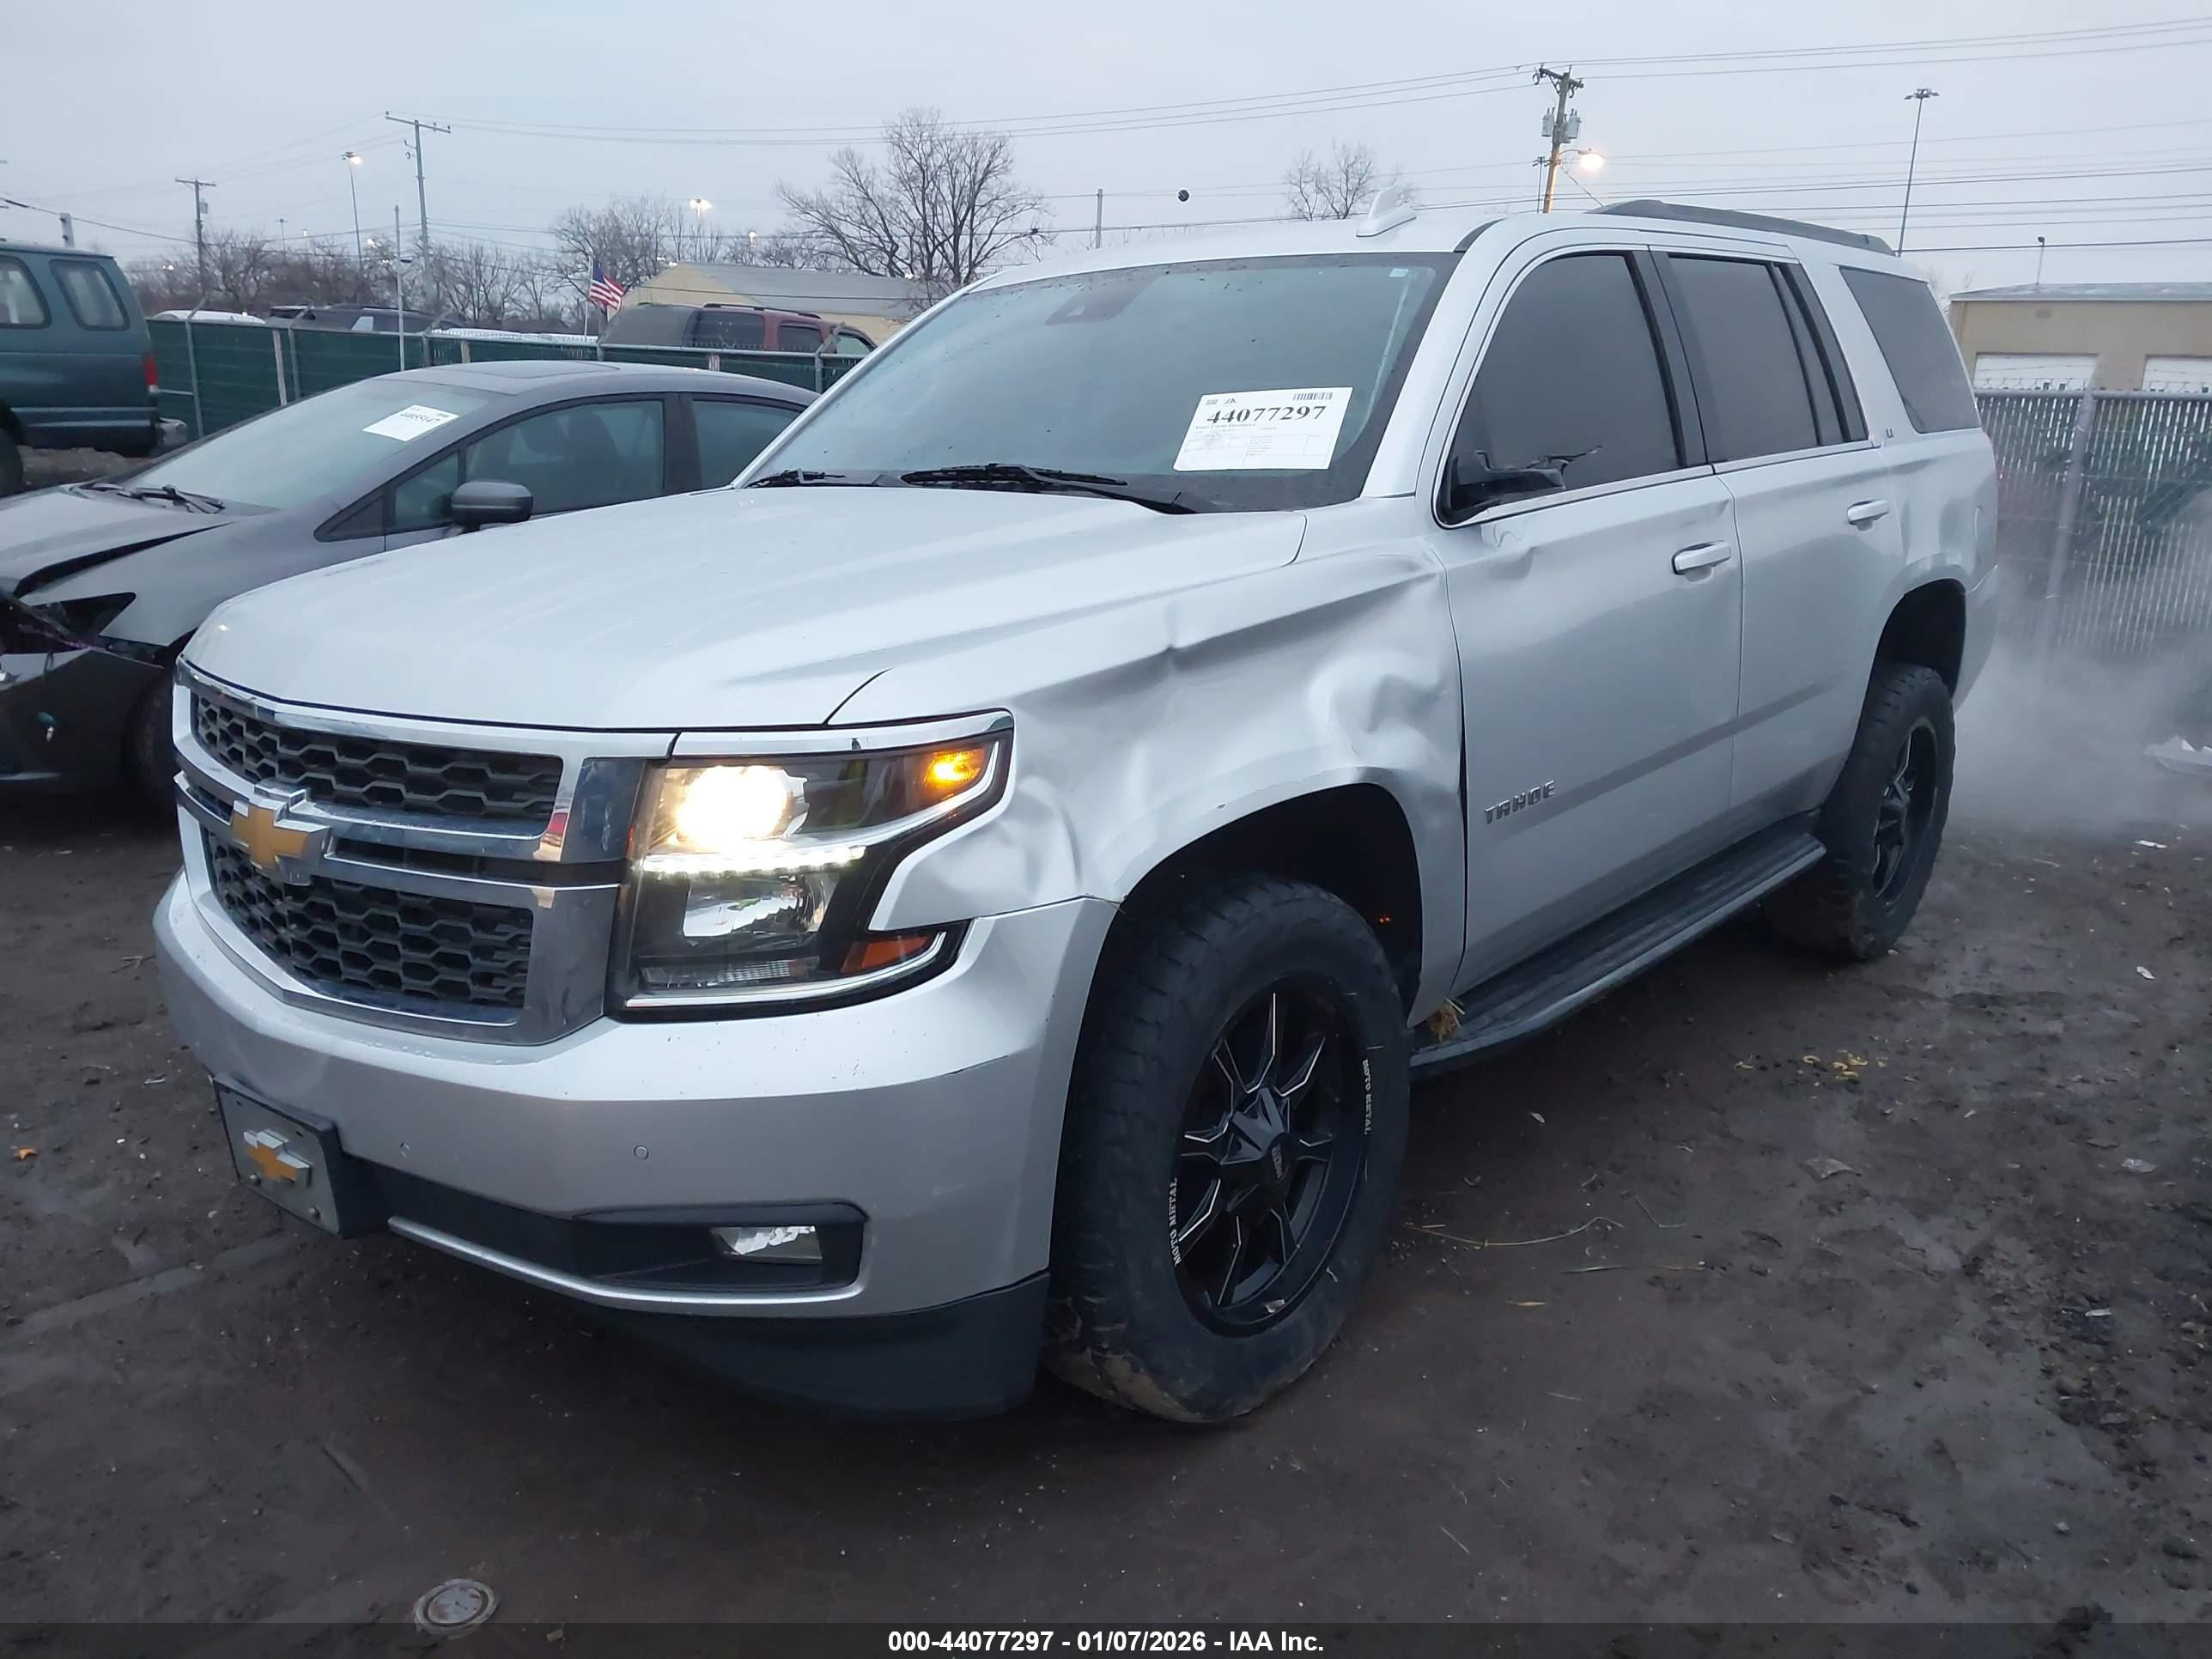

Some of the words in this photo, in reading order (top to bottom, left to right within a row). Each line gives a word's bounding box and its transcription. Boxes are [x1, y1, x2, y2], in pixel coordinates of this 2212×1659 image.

[1206, 405, 1327, 423] 44077297
[1484, 780, 1555, 825] TAHOE
[1362, 1059, 1371, 1091] MOTO
[1364, 1093, 1372, 1135] METAL
[1169, 1177, 1177, 1228] METAL
[1170, 1229, 1182, 1267] MOTO
